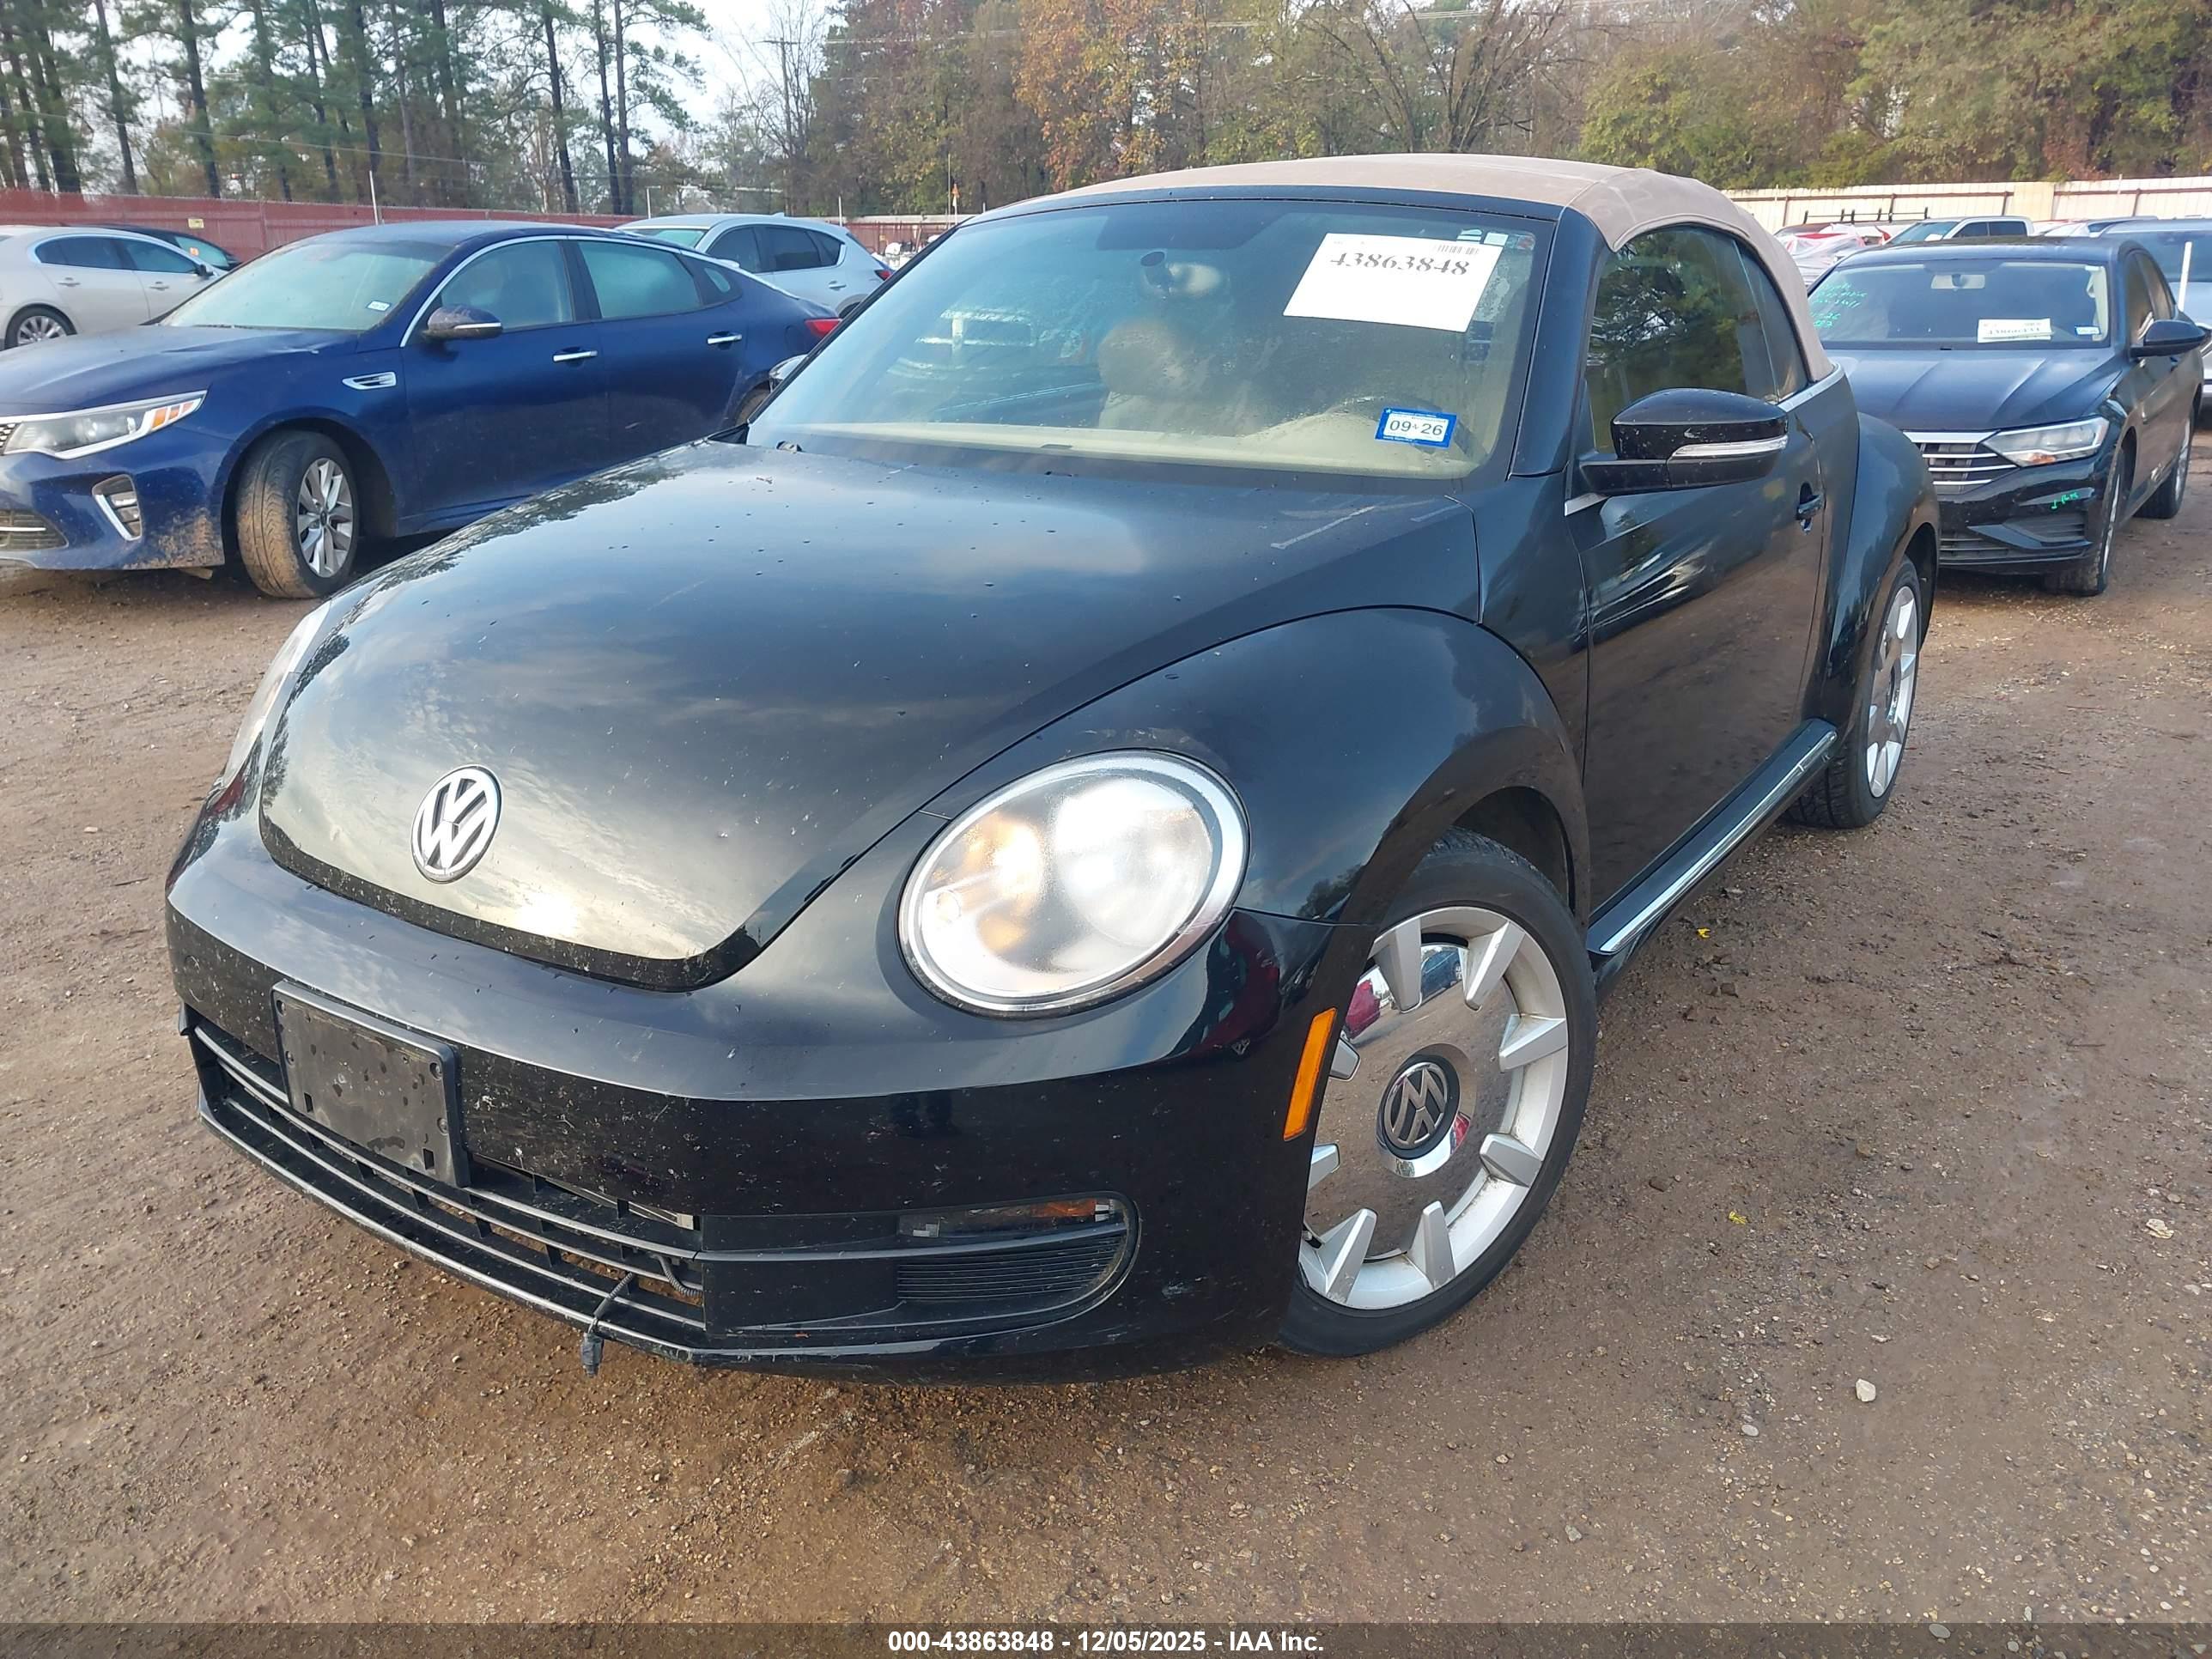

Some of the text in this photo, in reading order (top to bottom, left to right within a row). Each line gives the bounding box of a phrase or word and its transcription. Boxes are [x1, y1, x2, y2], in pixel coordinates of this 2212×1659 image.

[1330, 252, 1469, 275] 43863848
[412, 764, 501, 884] VW
[1383, 1062, 1448, 1149] VW
